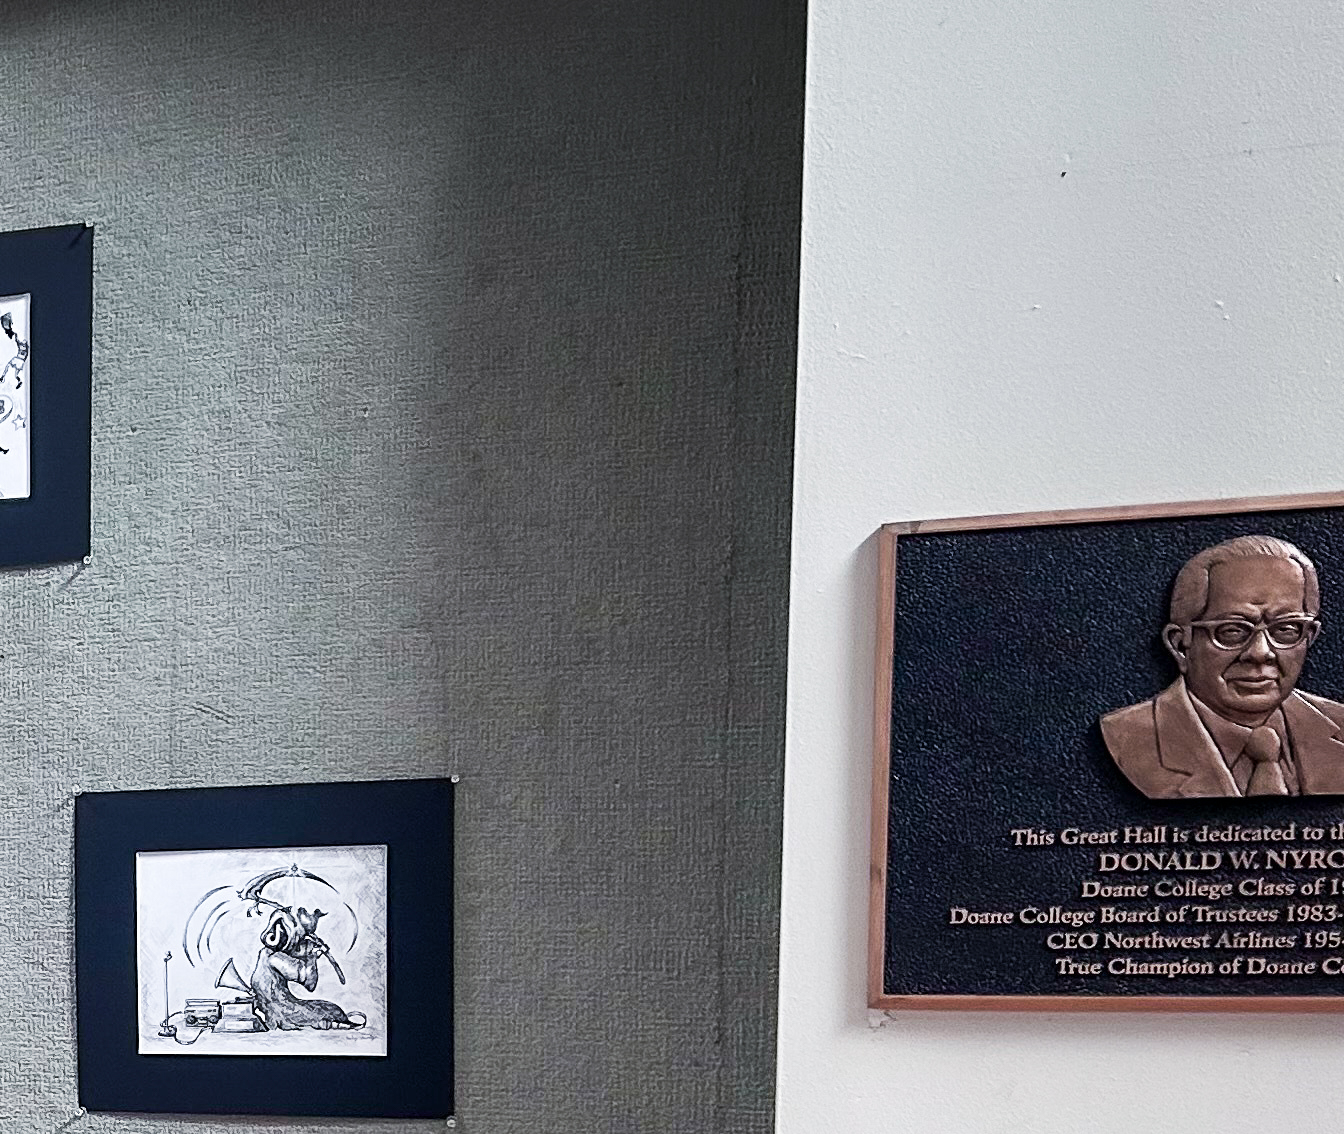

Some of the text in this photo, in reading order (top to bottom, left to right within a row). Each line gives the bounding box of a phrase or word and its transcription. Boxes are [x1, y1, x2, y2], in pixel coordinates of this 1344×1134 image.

[1011, 827, 1055, 846] This
[1060, 827, 1118, 845] Great
[1123, 825, 1166, 844] Hall
[1173, 826, 1190, 843] is
[1194, 822, 1296, 842] dedicated
[1302, 825, 1325, 841] to
[1099, 851, 1222, 872] DONALD
[1229, 850, 1261, 870] W.
[1081, 880, 1149, 898] Doane
[1154, 879, 1233, 900] College
[1238, 877, 1297, 897] Class
[1301, 876, 1326, 896] of
[949, 906, 1014, 925] Doane
[1019, 905, 1096, 927] College
[1100, 906, 1160, 924] Board
[1165, 904, 1190, 923] of
[1192, 906, 1279, 923] Trustees
[1046, 930, 1344, 950] CEO Northwest Airlines 195
[1055, 957, 1103, 975] True
[1107, 957, 1215, 978] Champion
[1218, 957, 1243, 975] of
[1247, 957, 1316, 975] Doane
